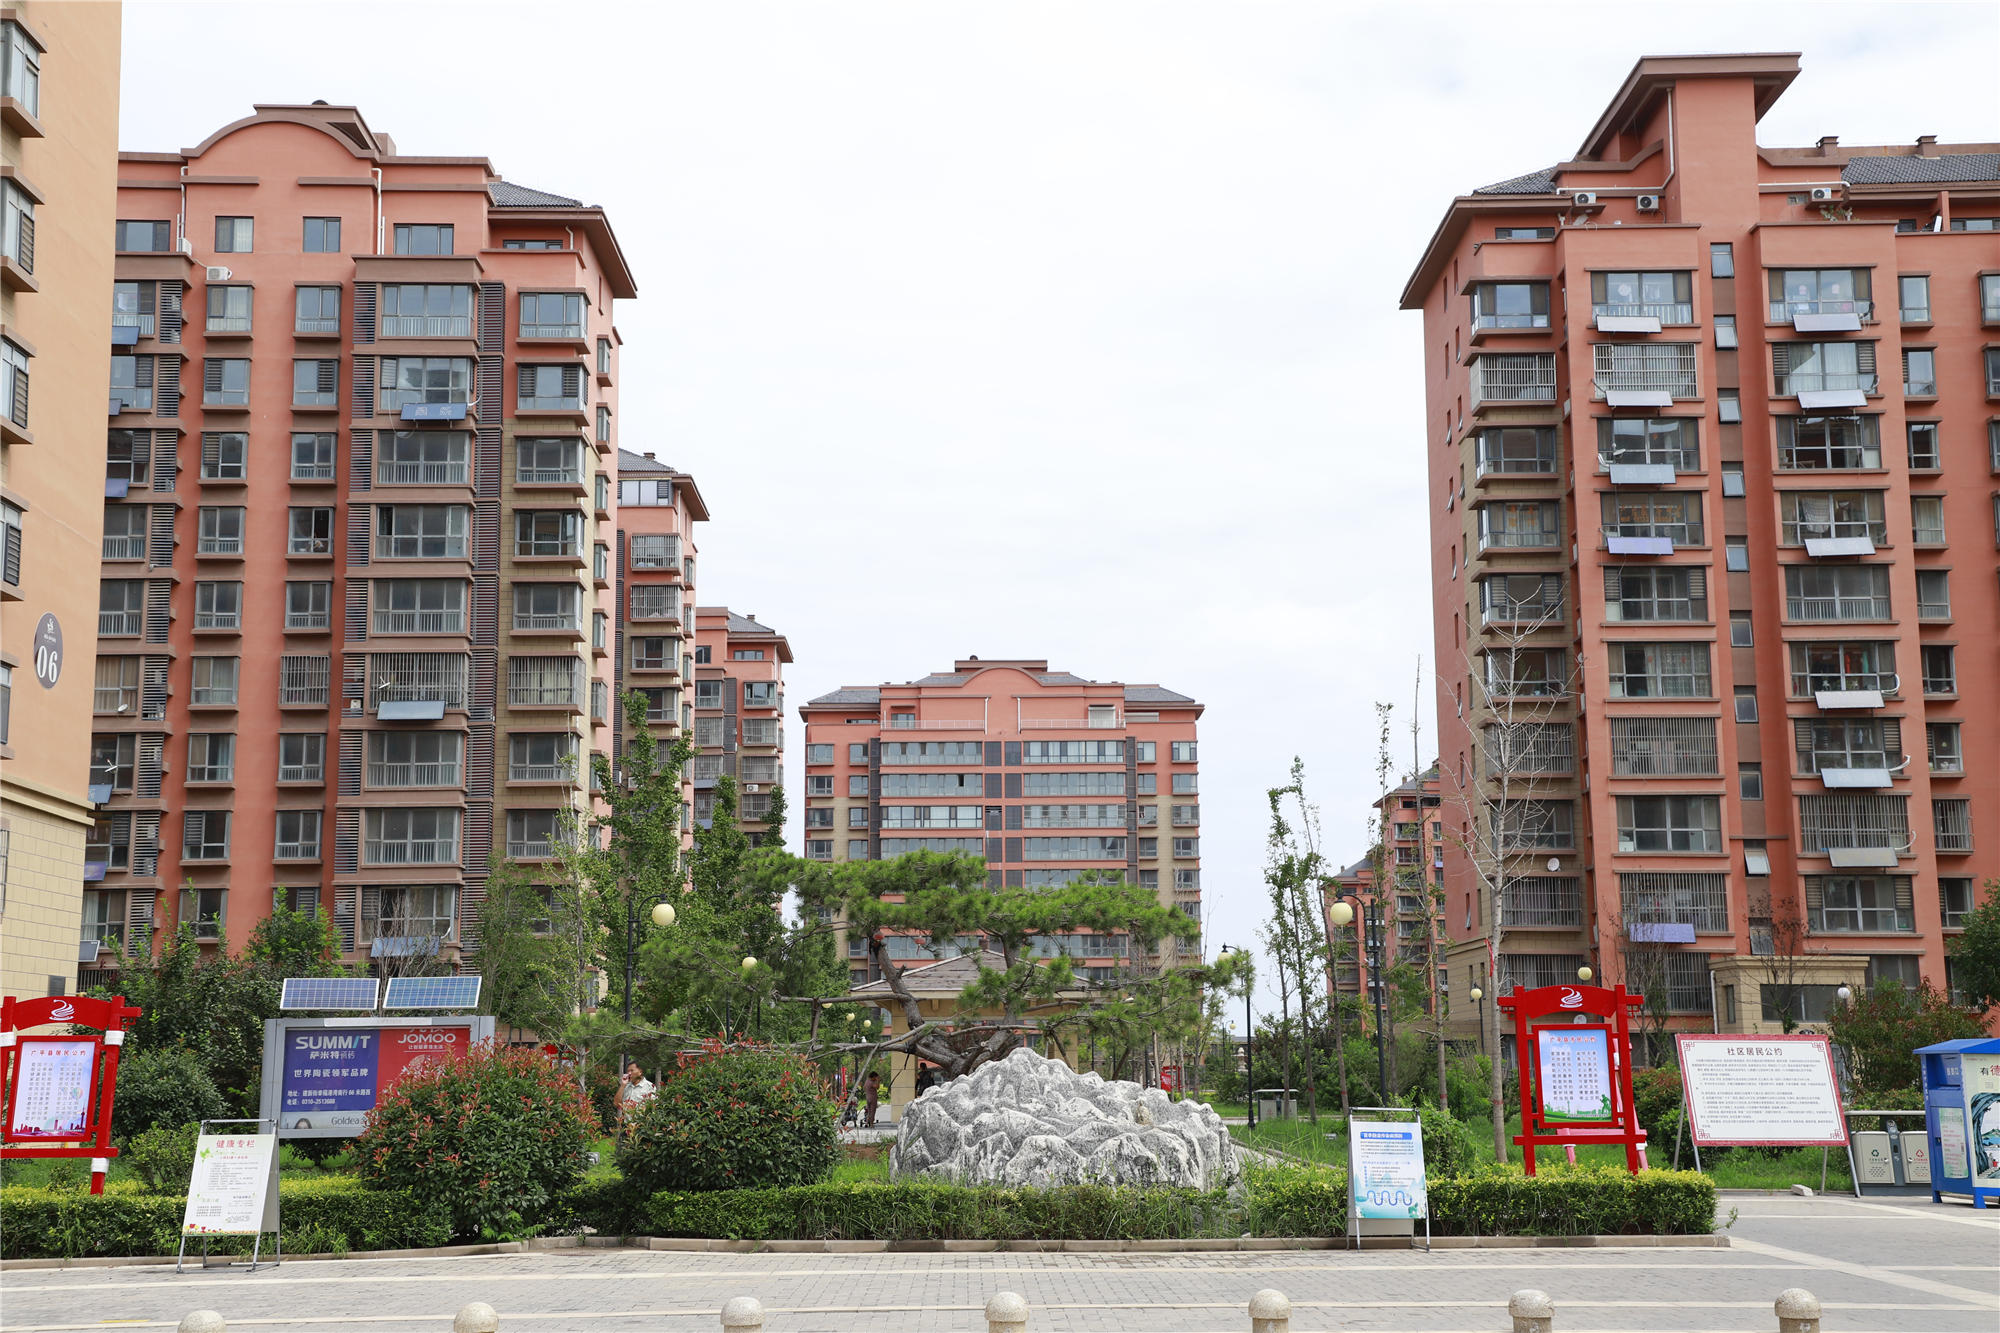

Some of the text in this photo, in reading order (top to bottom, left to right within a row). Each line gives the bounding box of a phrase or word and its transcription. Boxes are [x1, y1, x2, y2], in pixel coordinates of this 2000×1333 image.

[37, 645, 58, 683] 06
[295, 1035, 371, 1049] SUMMIT
[398, 1033, 456, 1043] JOMOO
[309, 1051, 356, 1060] 萨米特瓷砖
[1727, 1047, 1783, 1056] 社区居民公约
[294, 1068, 369, 1078] 世界陶瓷领军品牌
[331, 1116, 360, 1125] Goldea
[216, 1139, 255, 1148] 健康专栏
